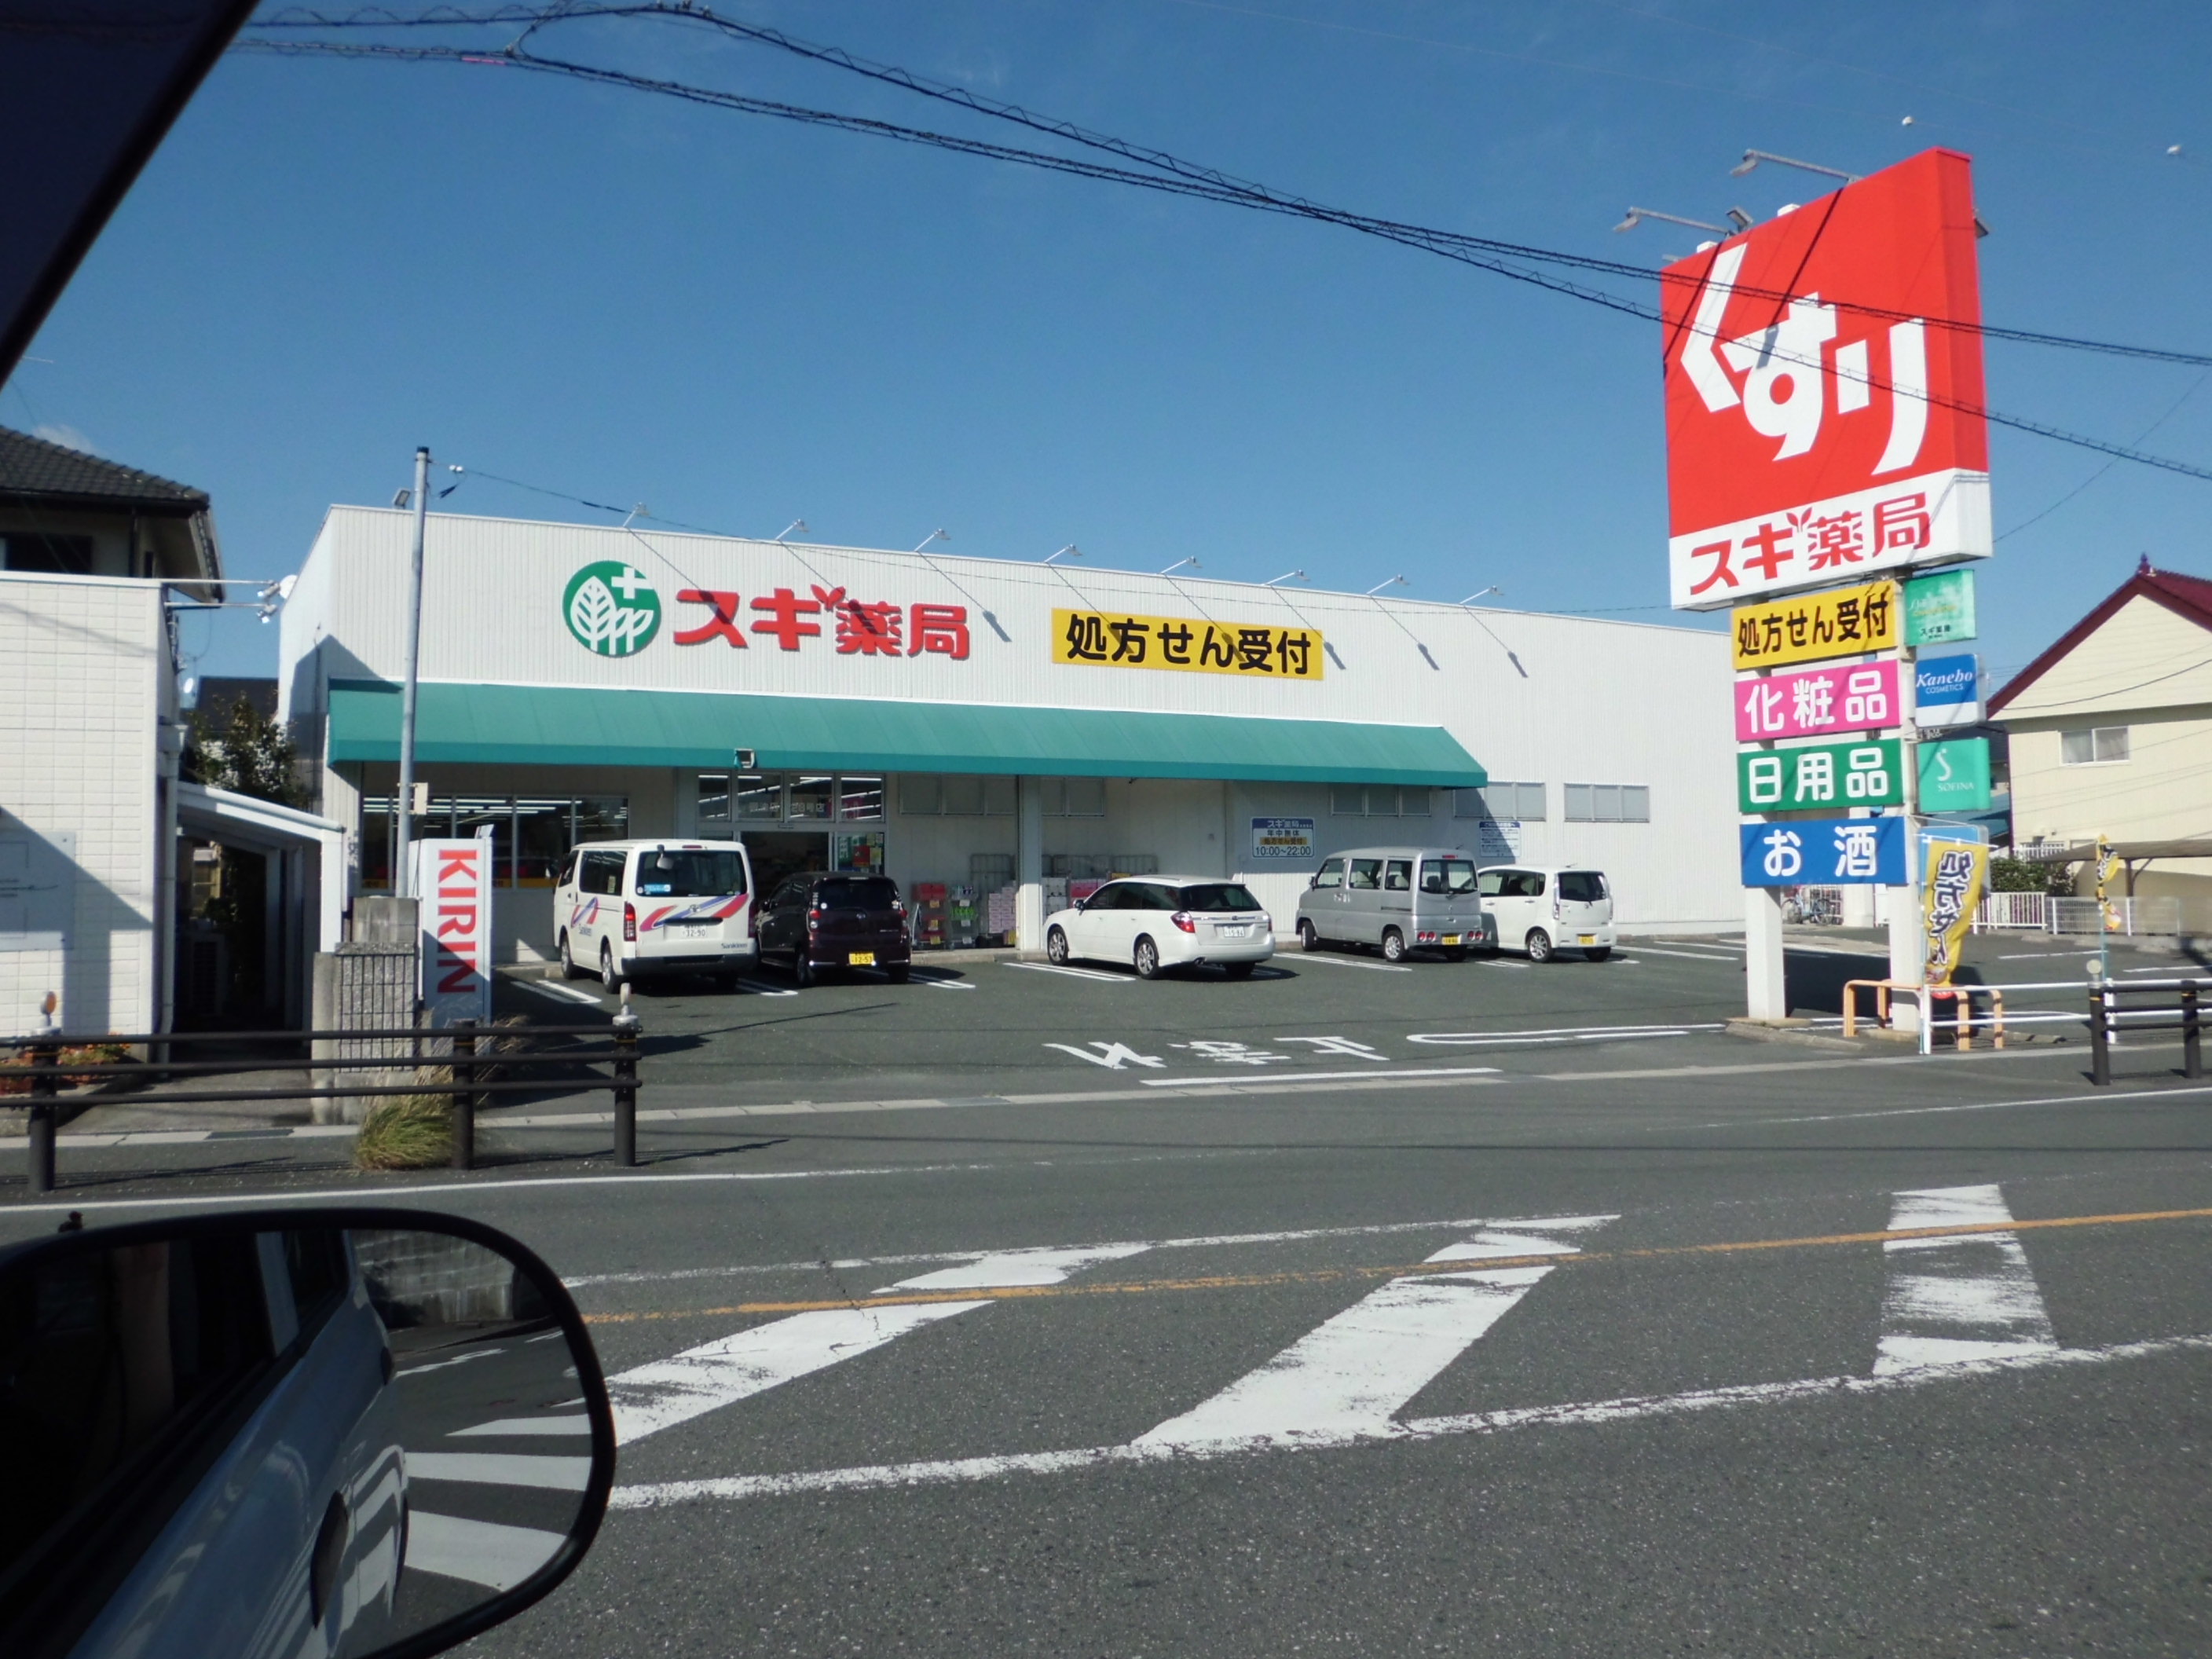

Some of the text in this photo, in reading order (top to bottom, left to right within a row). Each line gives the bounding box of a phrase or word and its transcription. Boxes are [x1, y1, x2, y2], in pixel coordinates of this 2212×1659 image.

[1680, 242, 1929, 475] くすり
[1690, 492, 1931, 596] スギ薬局
[674, 584, 969, 660] スギ薬局
[1066, 613, 1312, 676] 処方せん受付
[1738, 593, 1889, 657] 処方せん受付
[1745, 670, 1888, 734] 化粧品
[1916, 668, 1972, 687] Kanebo
[1925, 683, 1964, 694] COSMETICS
[1749, 747, 1888, 804] 日用品
[1937, 782, 1974, 792] SOFINA
[1763, 826, 1877, 878] お酒
[437, 849, 477, 993] KIRIN
